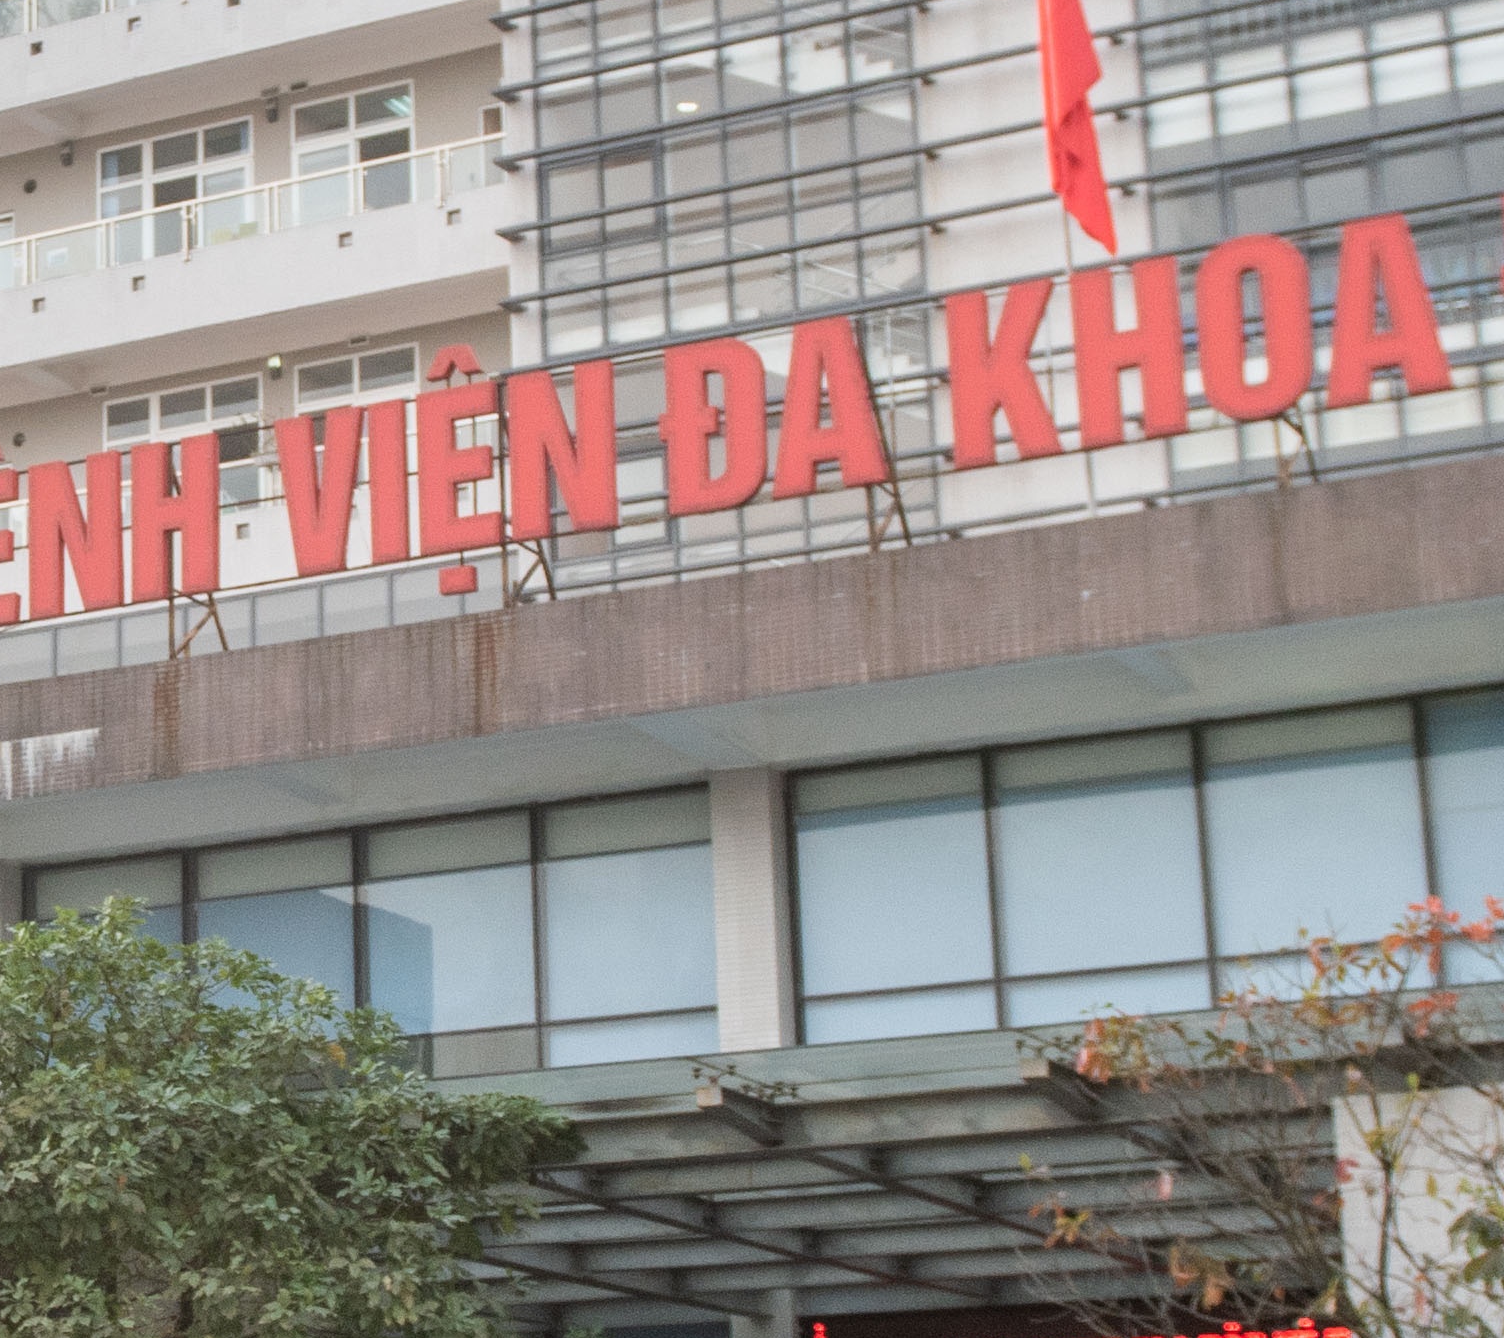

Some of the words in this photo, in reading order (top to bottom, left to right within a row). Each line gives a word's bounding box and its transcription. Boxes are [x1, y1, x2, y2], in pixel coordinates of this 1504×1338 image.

[273, 344, 619, 596] VIỆN
[658, 315, 890, 516] ĐA
[944, 212, 1453, 470] KHOA
